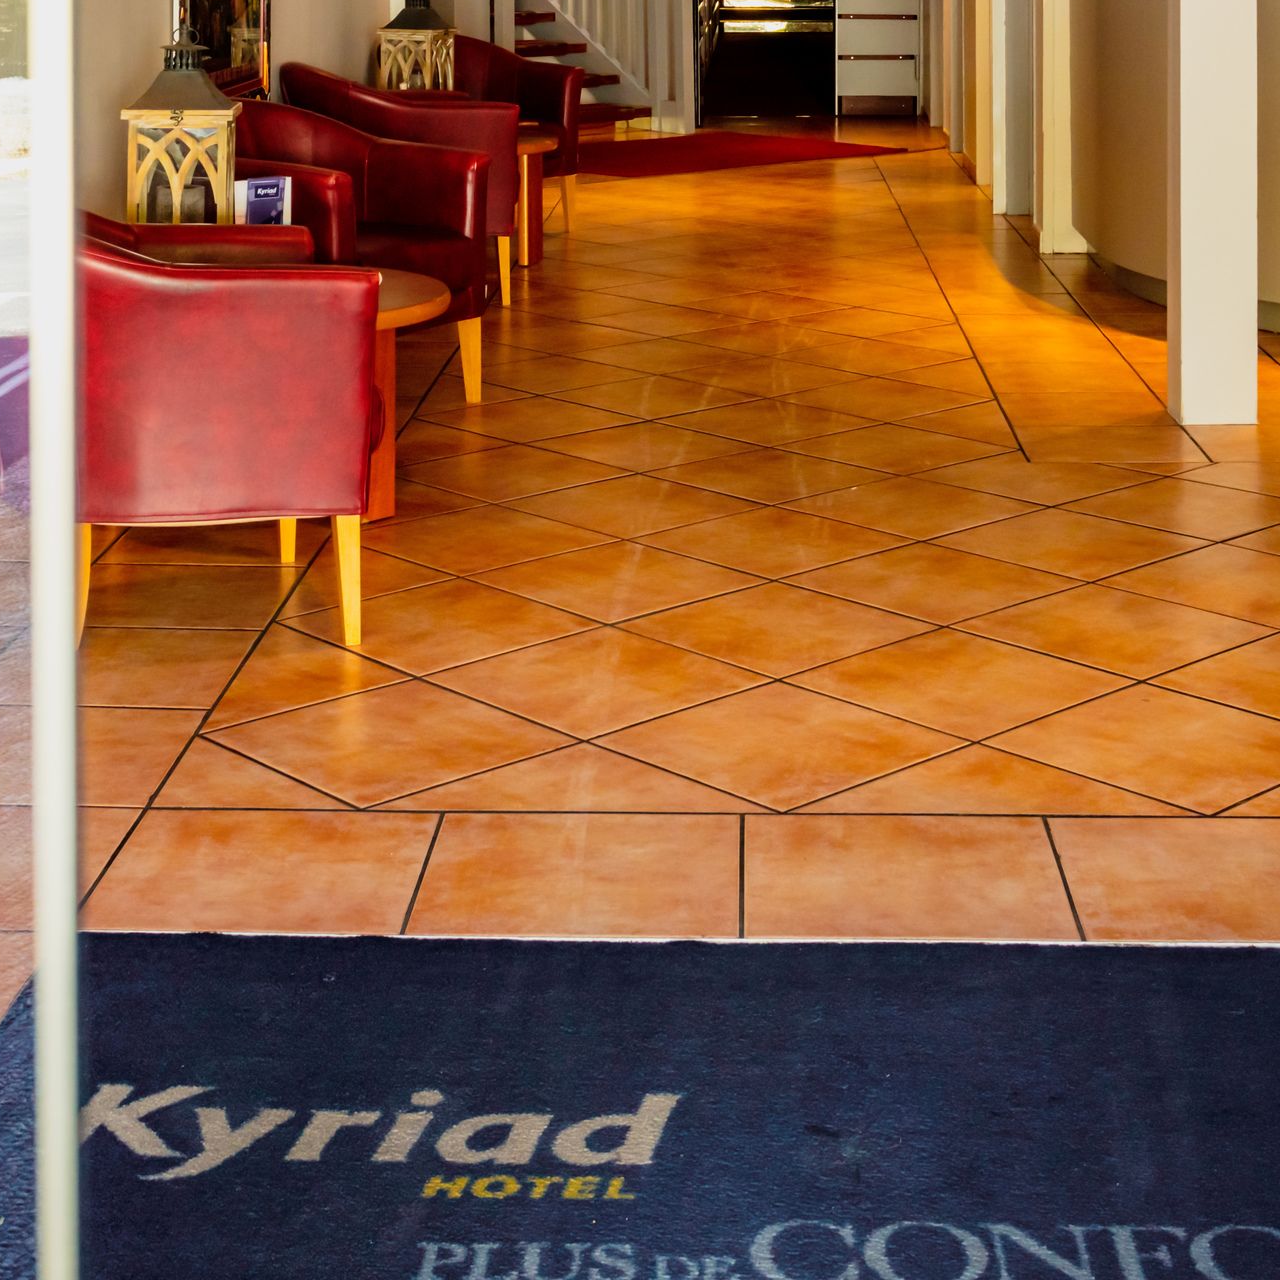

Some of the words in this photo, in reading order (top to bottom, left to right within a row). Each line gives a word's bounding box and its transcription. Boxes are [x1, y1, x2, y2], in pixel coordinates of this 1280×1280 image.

[257, 187, 277, 195] Kyriad
[79, 1083, 680, 1181] Kyriad
[421, 1175, 636, 1200] HOTEL
[417, 1241, 635, 1280] PLUS
